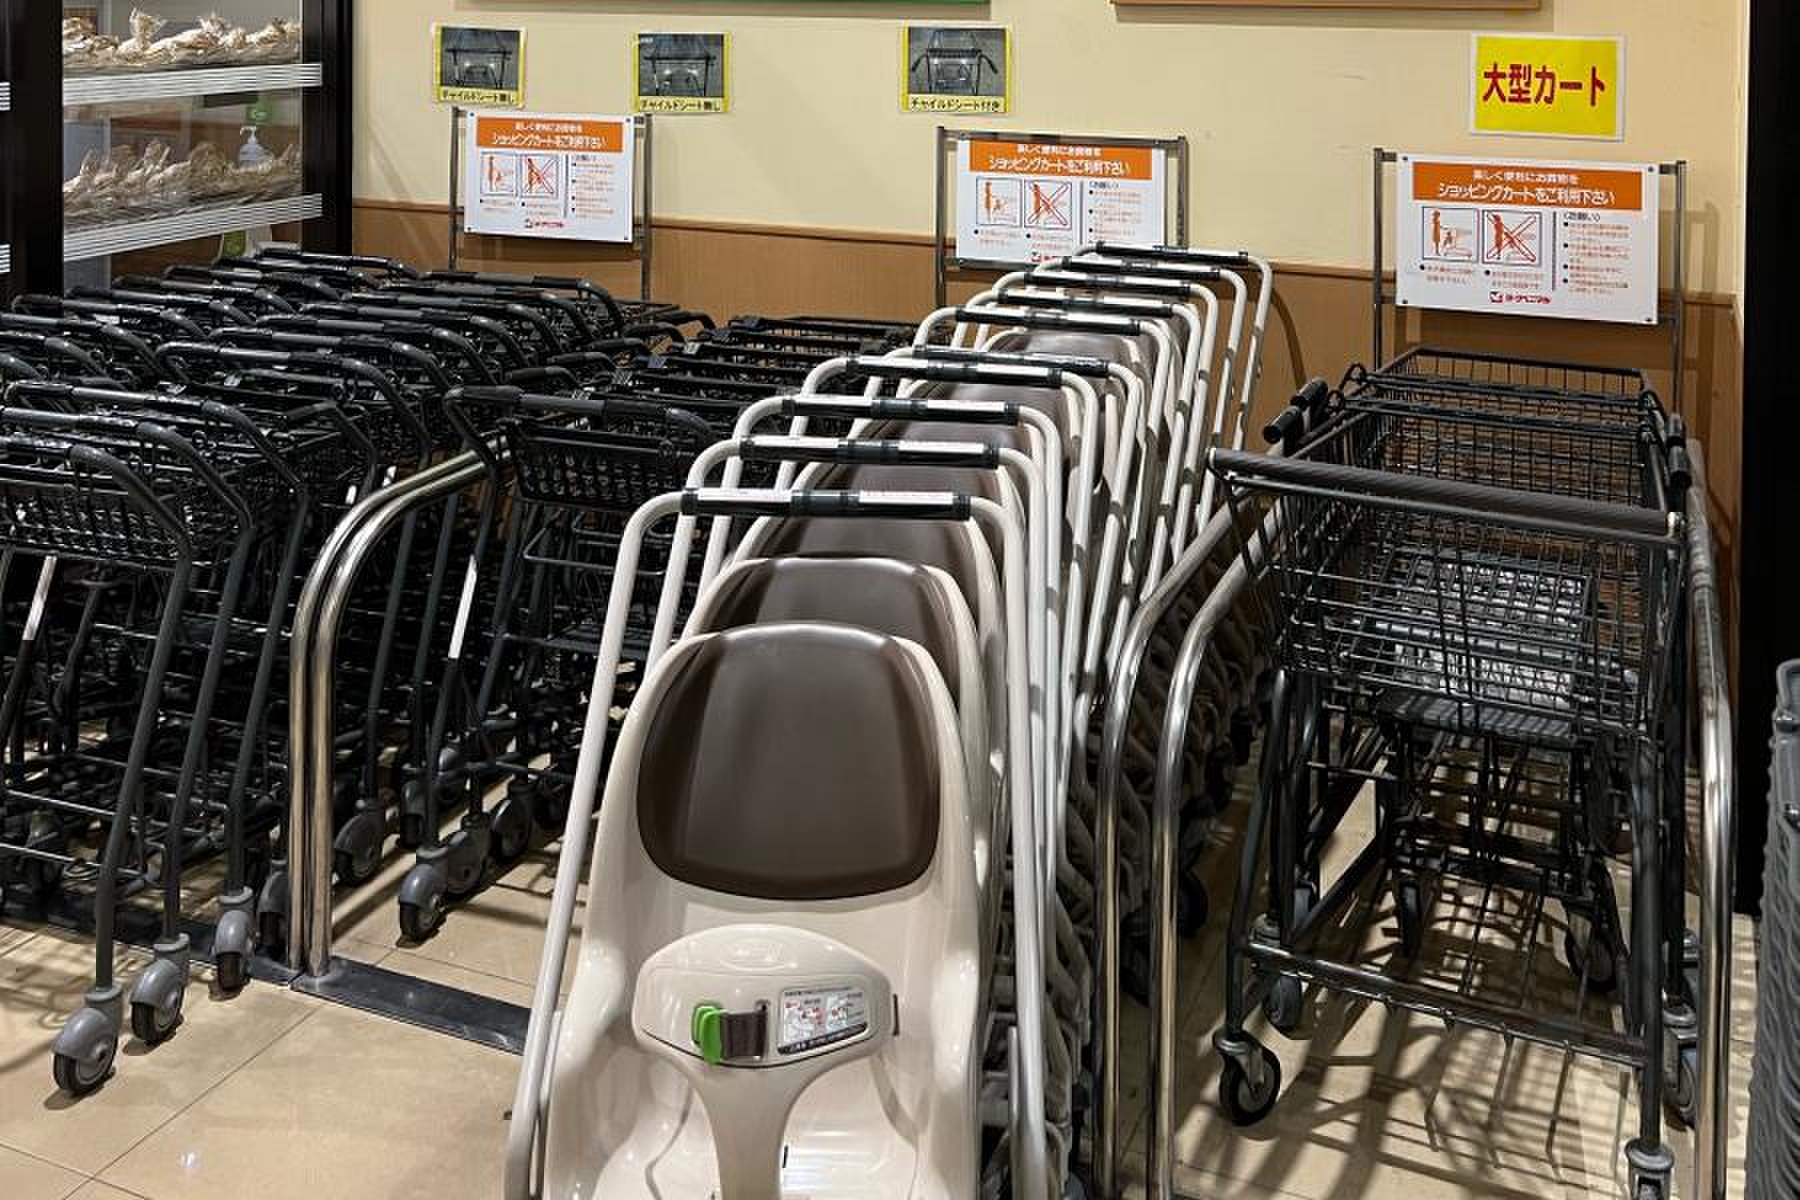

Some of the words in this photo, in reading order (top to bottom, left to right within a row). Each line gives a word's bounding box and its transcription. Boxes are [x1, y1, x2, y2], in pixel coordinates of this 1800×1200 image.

[1482, 62, 1606, 107] 大型カート
[1438, 182, 1616, 206] ショッピングカートをご利用下さい
